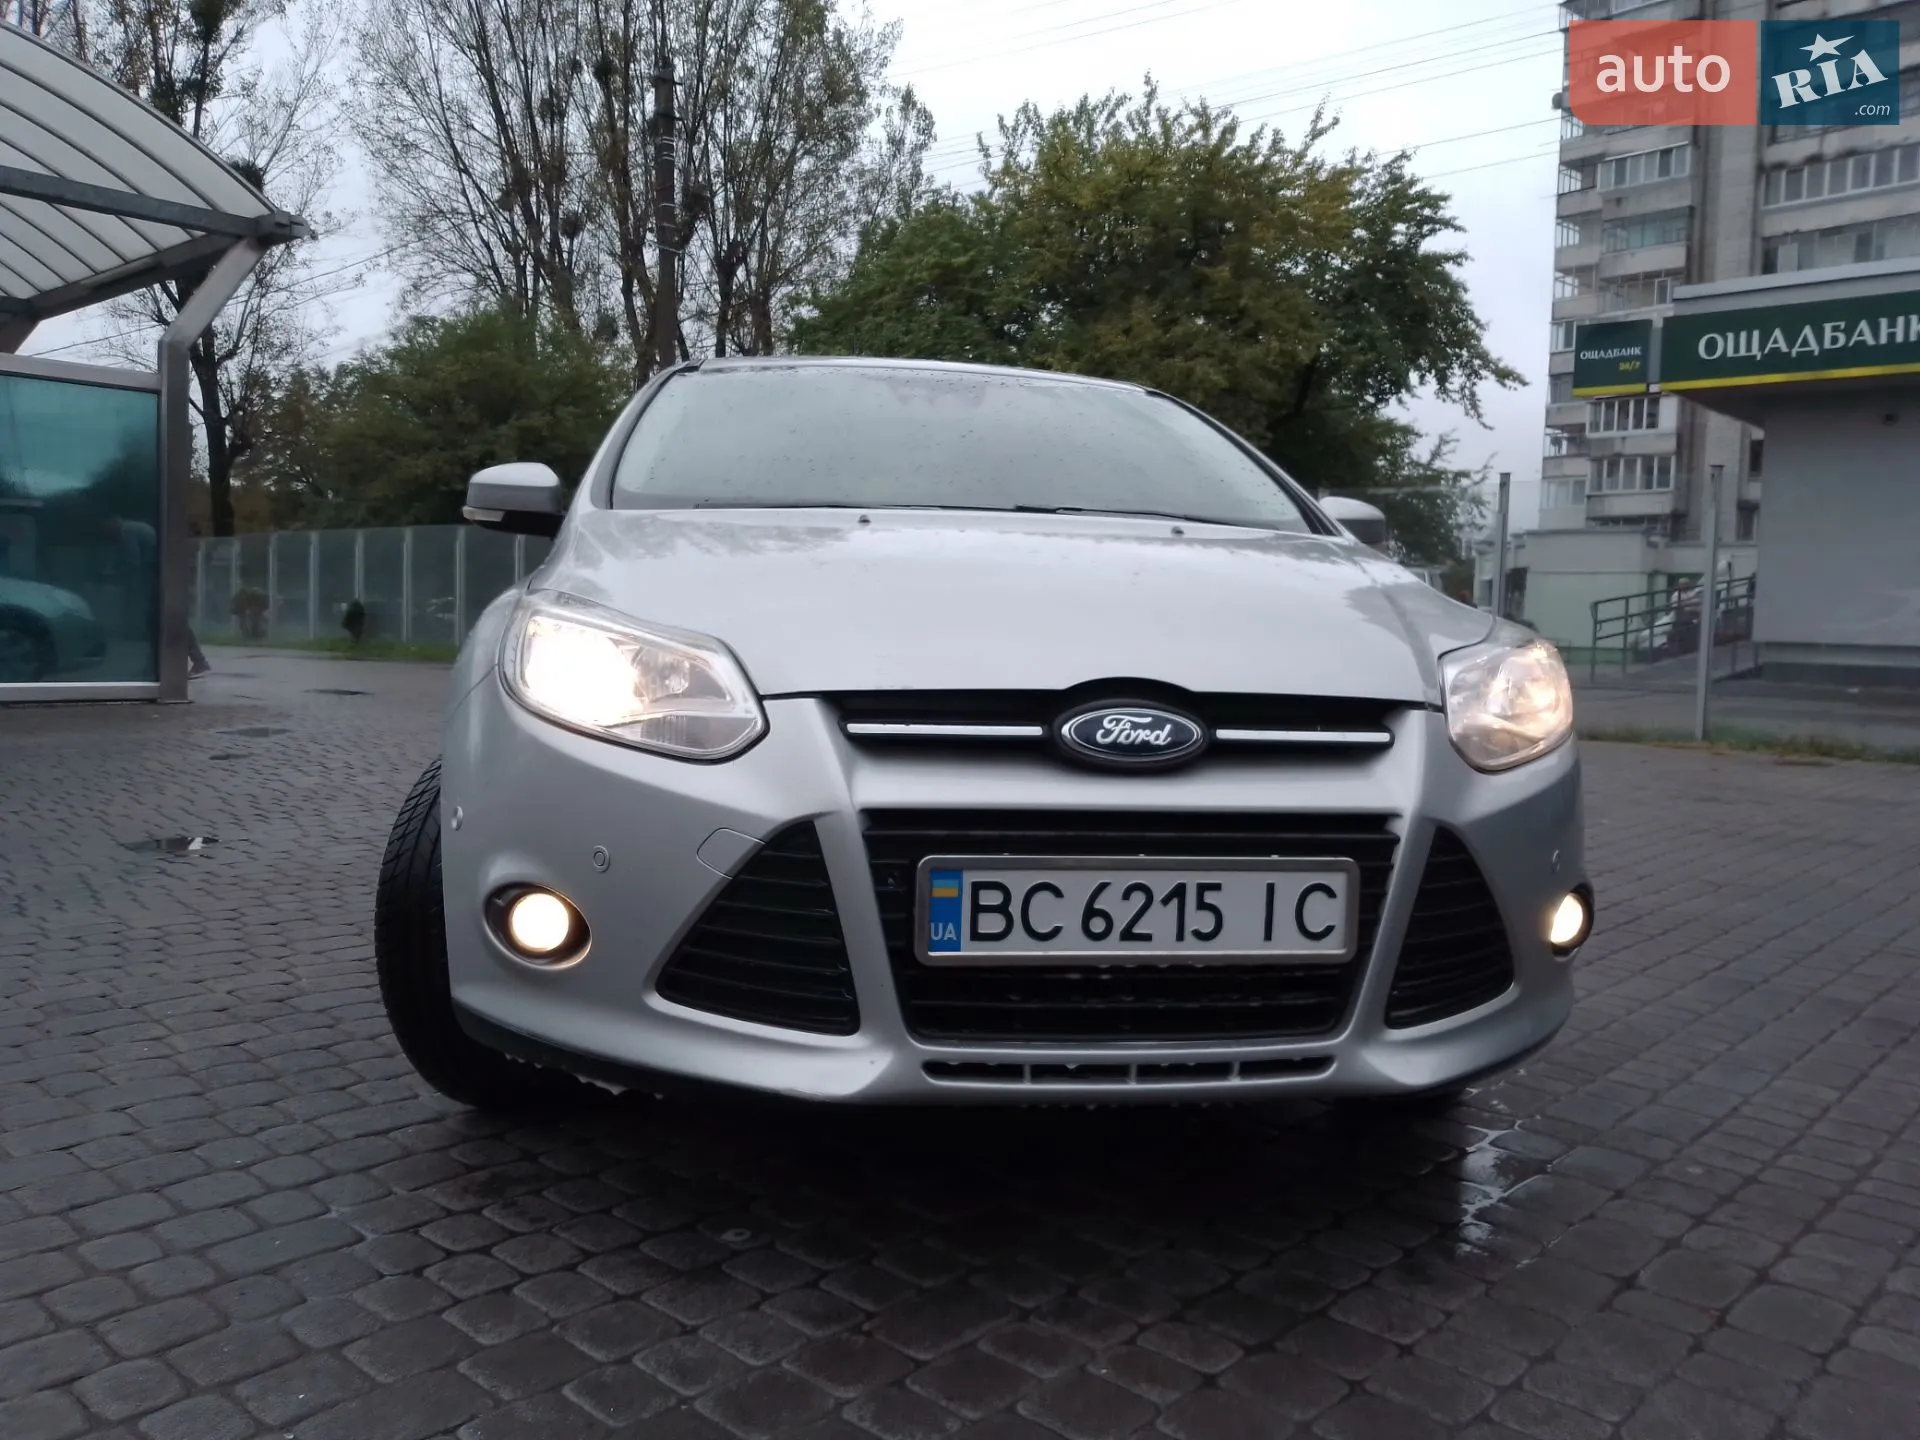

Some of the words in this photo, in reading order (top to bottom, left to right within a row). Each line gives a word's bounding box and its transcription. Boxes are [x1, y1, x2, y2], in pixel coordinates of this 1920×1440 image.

[1096, 715, 1171, 745] Ford
[969, 881, 1065, 942] BC
[1081, 882, 1223, 942] 6215
[1263, 882, 1338, 941] IC
[930, 922, 957, 941] UA
